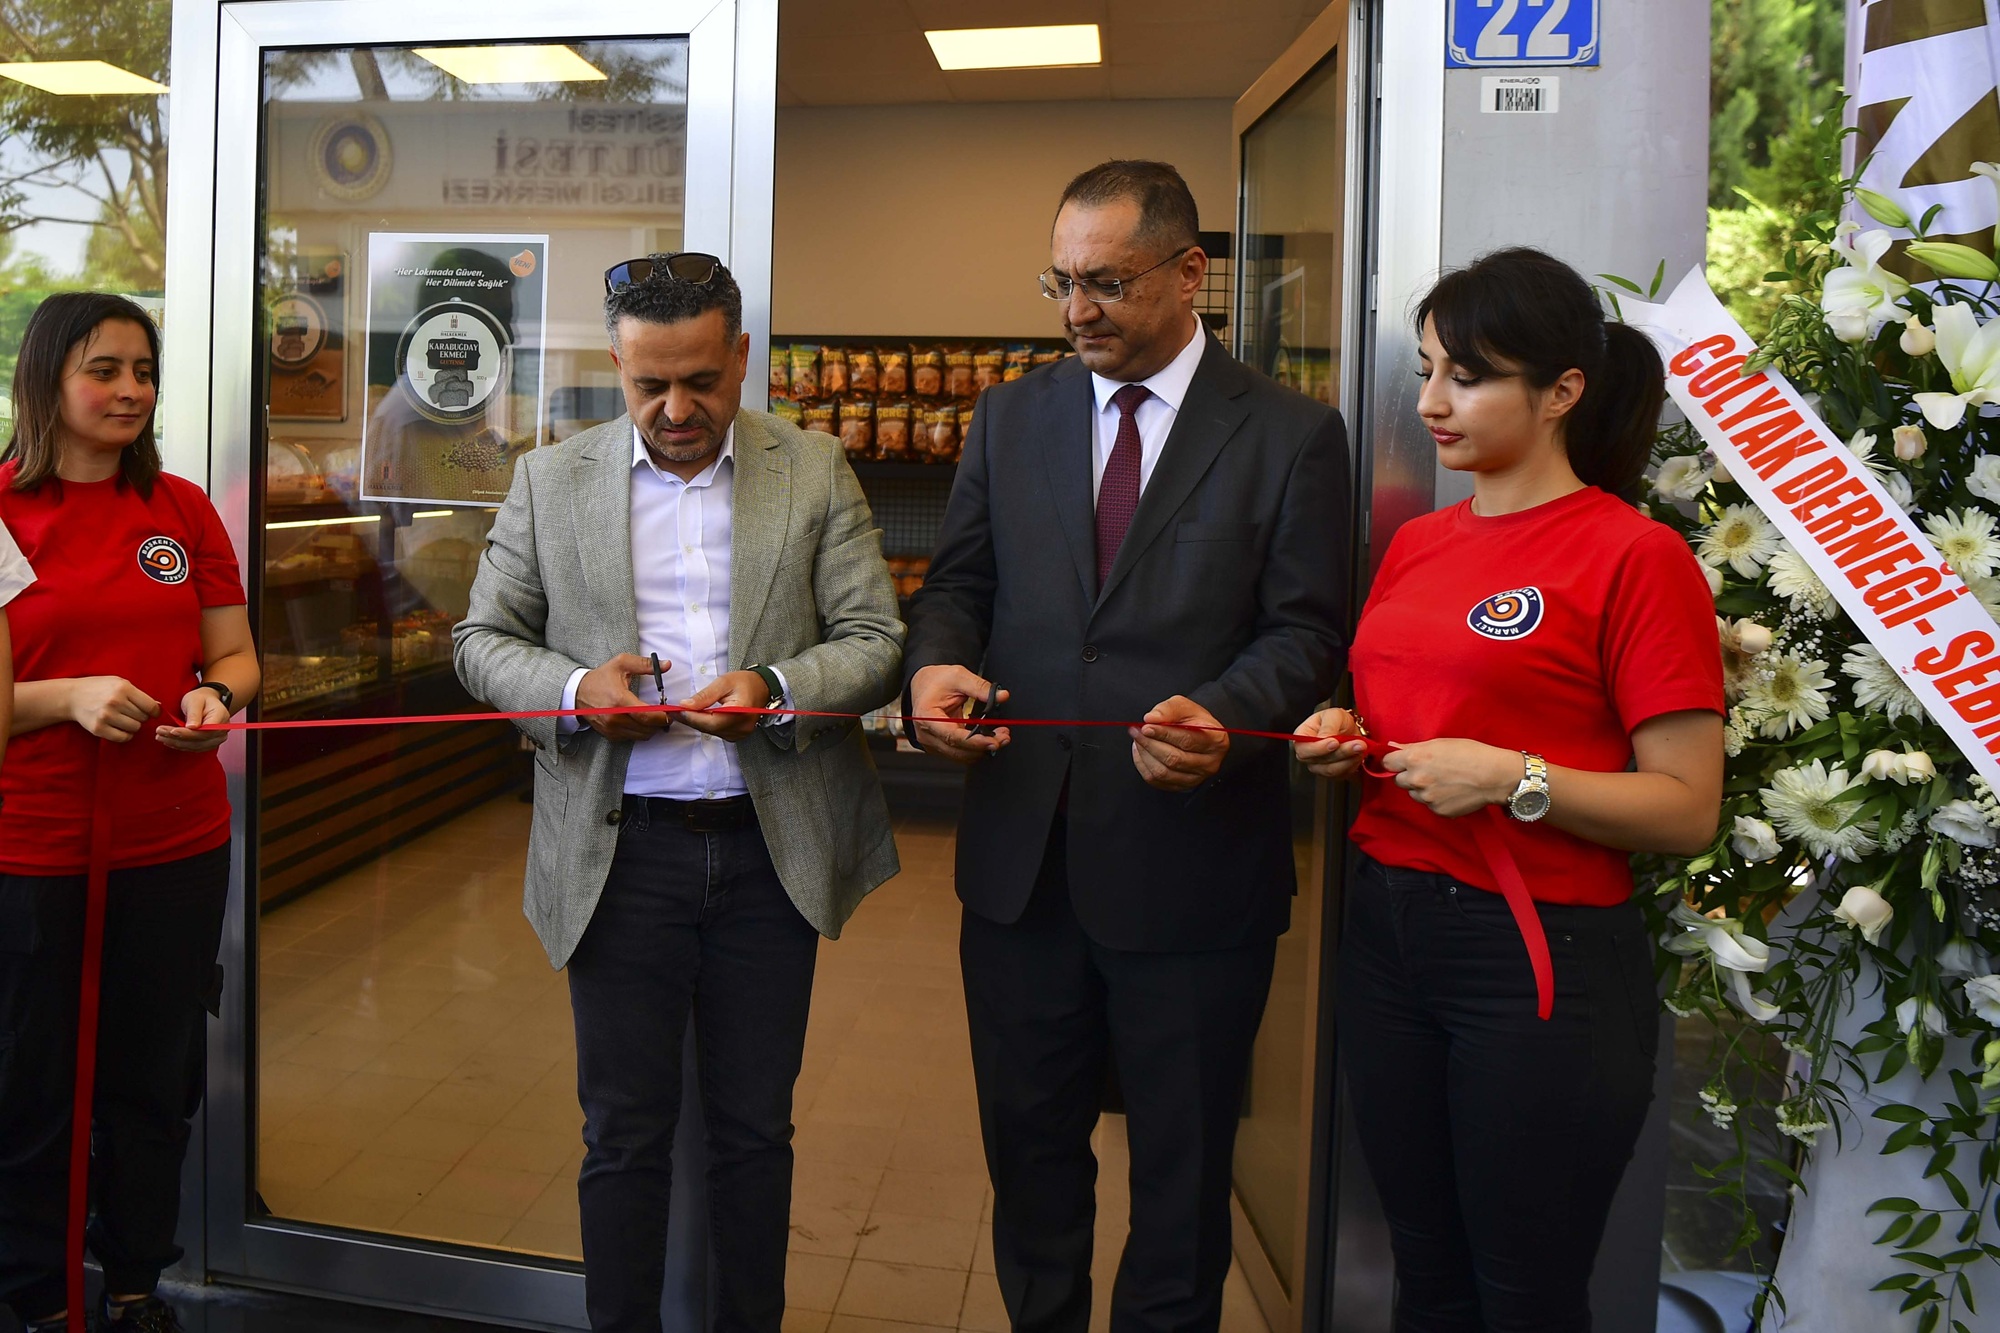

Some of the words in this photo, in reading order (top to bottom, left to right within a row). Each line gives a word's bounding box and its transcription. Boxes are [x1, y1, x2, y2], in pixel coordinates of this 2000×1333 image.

[1475, 0, 1569, 57] 22
[414, 268, 454, 276] Lokmada
[455, 268, 485, 277] Güven,
[425, 278, 442, 287] Her
[442, 279, 475, 287] Dilimde
[429, 342, 479, 352] KARABUĞDAY
[1475, 622, 1519, 635] MARKET
